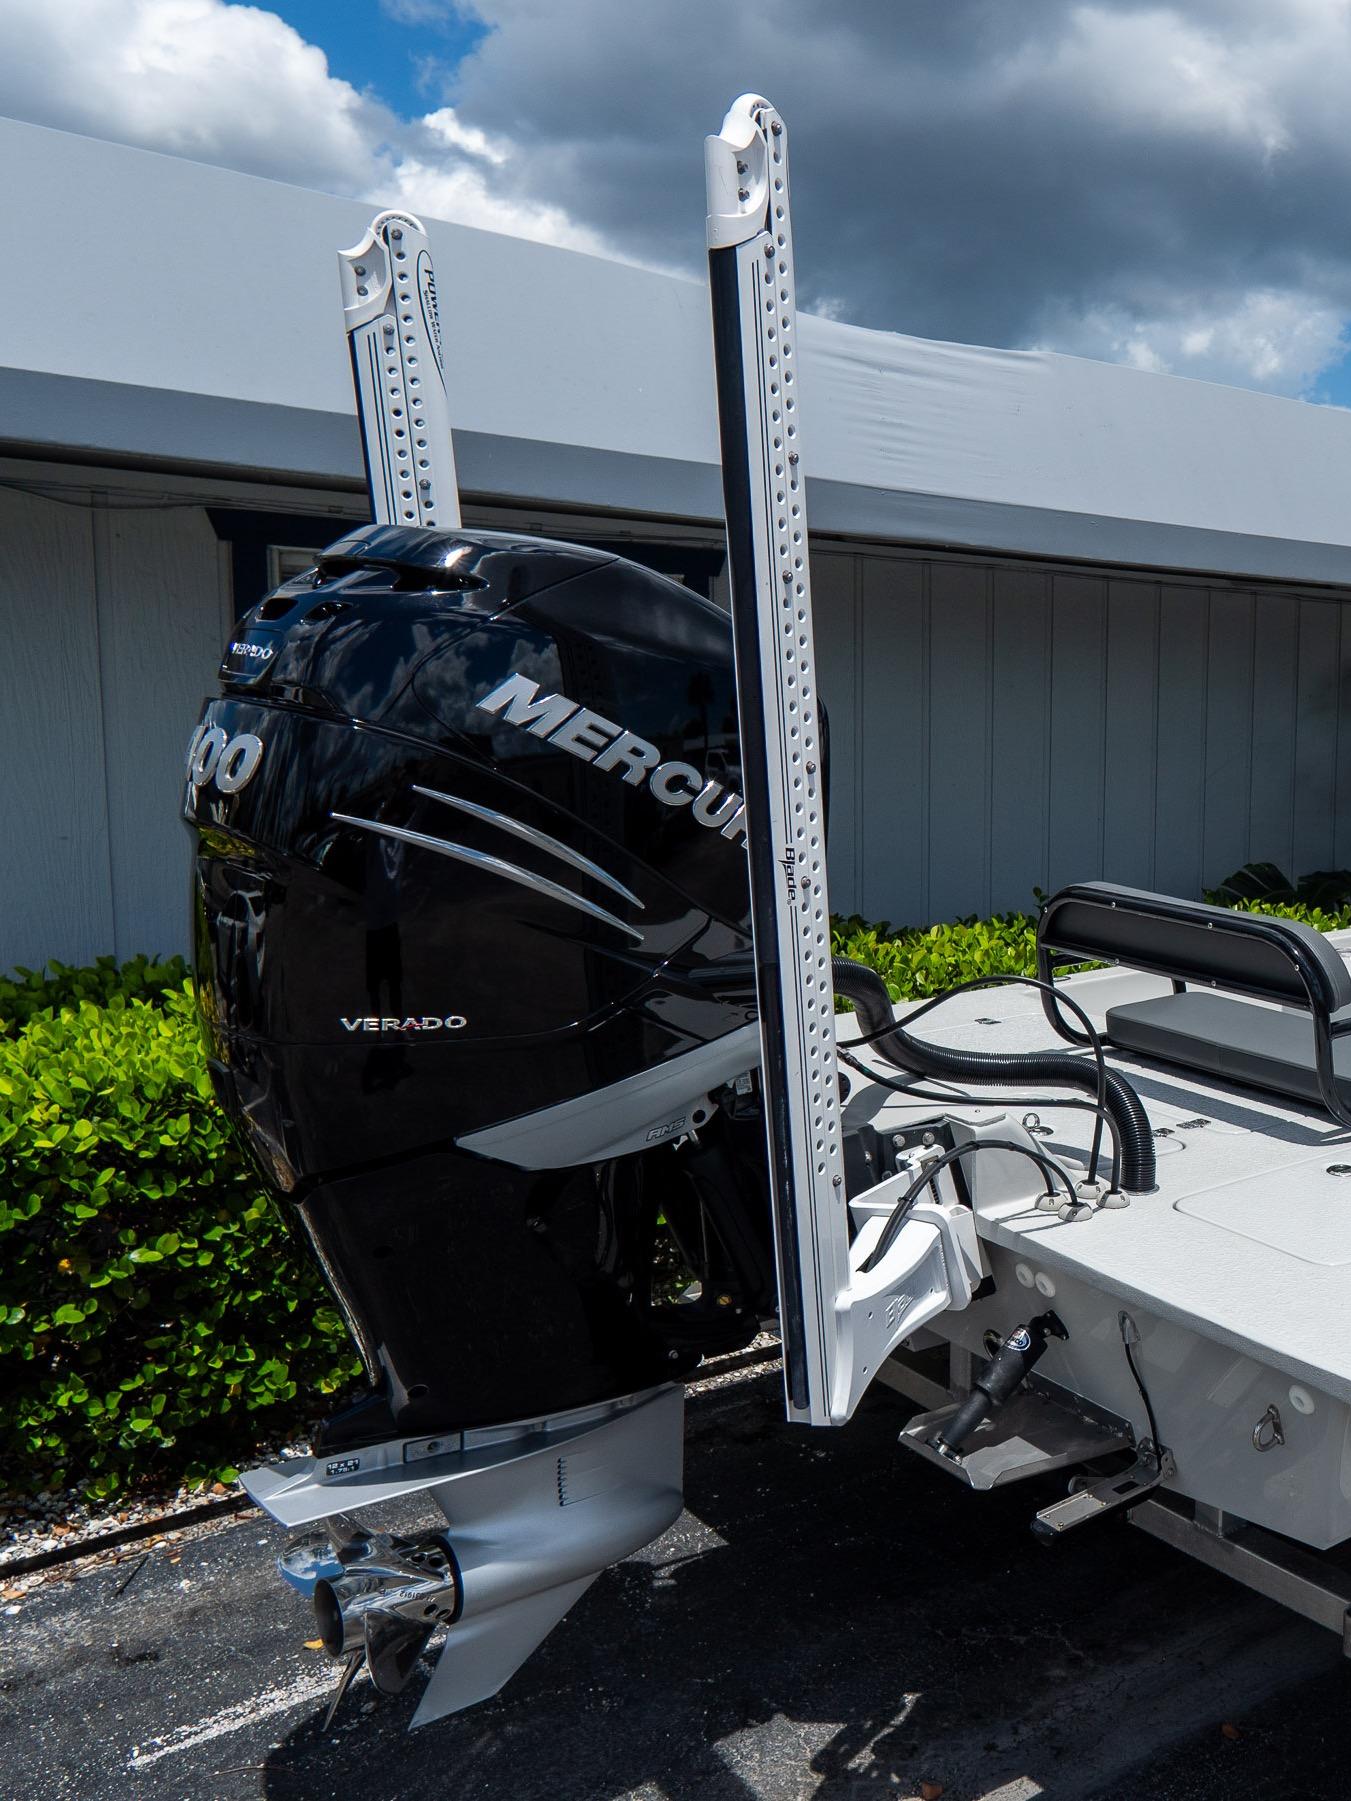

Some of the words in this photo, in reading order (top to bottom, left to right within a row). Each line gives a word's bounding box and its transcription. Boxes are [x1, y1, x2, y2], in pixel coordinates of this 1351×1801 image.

[475, 672, 750, 851] MERCU
[778, 847, 797, 902] Blade
[340, 1015, 467, 1031] VERADO
